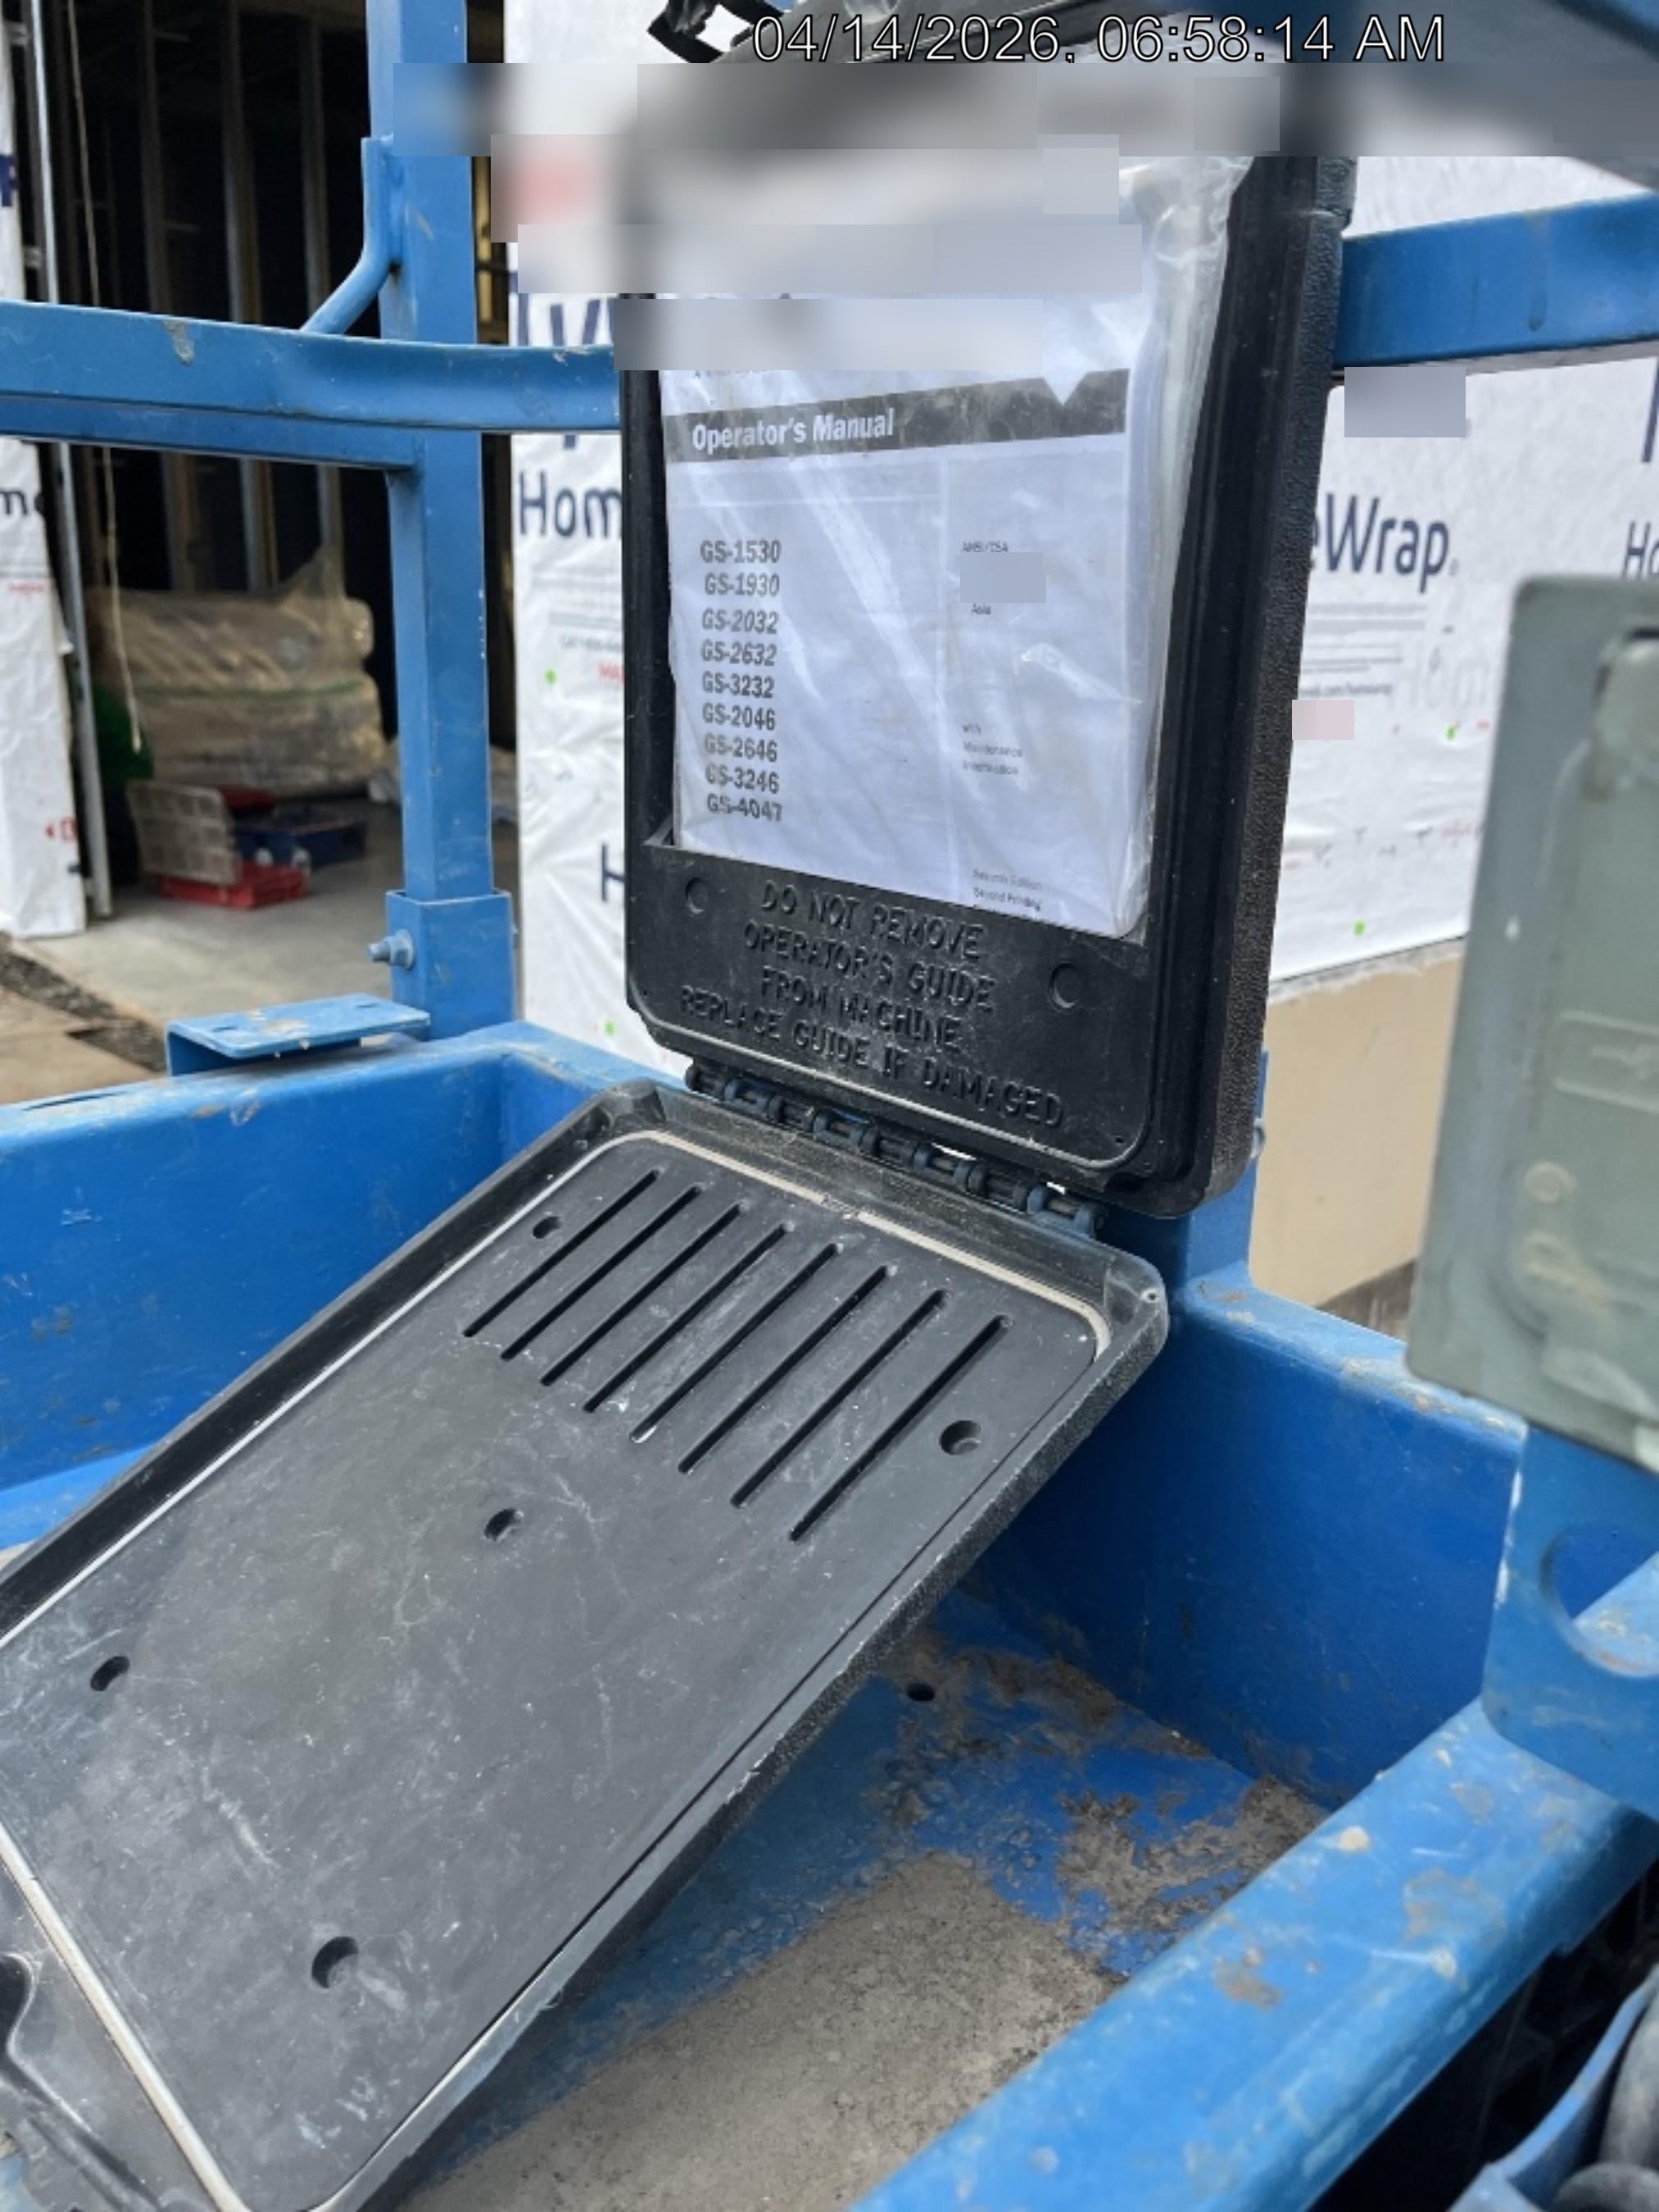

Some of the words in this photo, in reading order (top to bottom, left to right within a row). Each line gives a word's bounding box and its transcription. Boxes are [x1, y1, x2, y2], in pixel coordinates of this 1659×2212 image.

[692, 418, 807, 456] Operator's
[812, 408, 895, 443] Manual
[700, 539, 782, 564] GS-1530
[1312, 493, 1449, 594] Wrap
[705, 573, 780, 596] GS-1930
[702, 608, 779, 634] GS-2032
[701, 639, 777, 667] GS-2632
[702, 671, 774, 699] GS-3232
[702, 702, 775, 731] GS-2046
[705, 733, 778, 763] GS-2646
[705, 763, 780, 794] GS-3246
[707, 793, 782, 822] GS-4047
[761, 880, 798, 915] DO
[807, 891, 859, 930] NOT
[871, 904, 985, 960] REMOVE
[743, 918, 895, 986] OPERATOR'S
[908, 961, 997, 1014] GUIDE
[760, 965, 828, 1008] FROM
[681, 985, 783, 1041] REPLACE
[792, 1018, 872, 1065] GUIDE
[883, 1045, 909, 1080] IF
[923, 1056, 1063, 1129] DAMAGED
